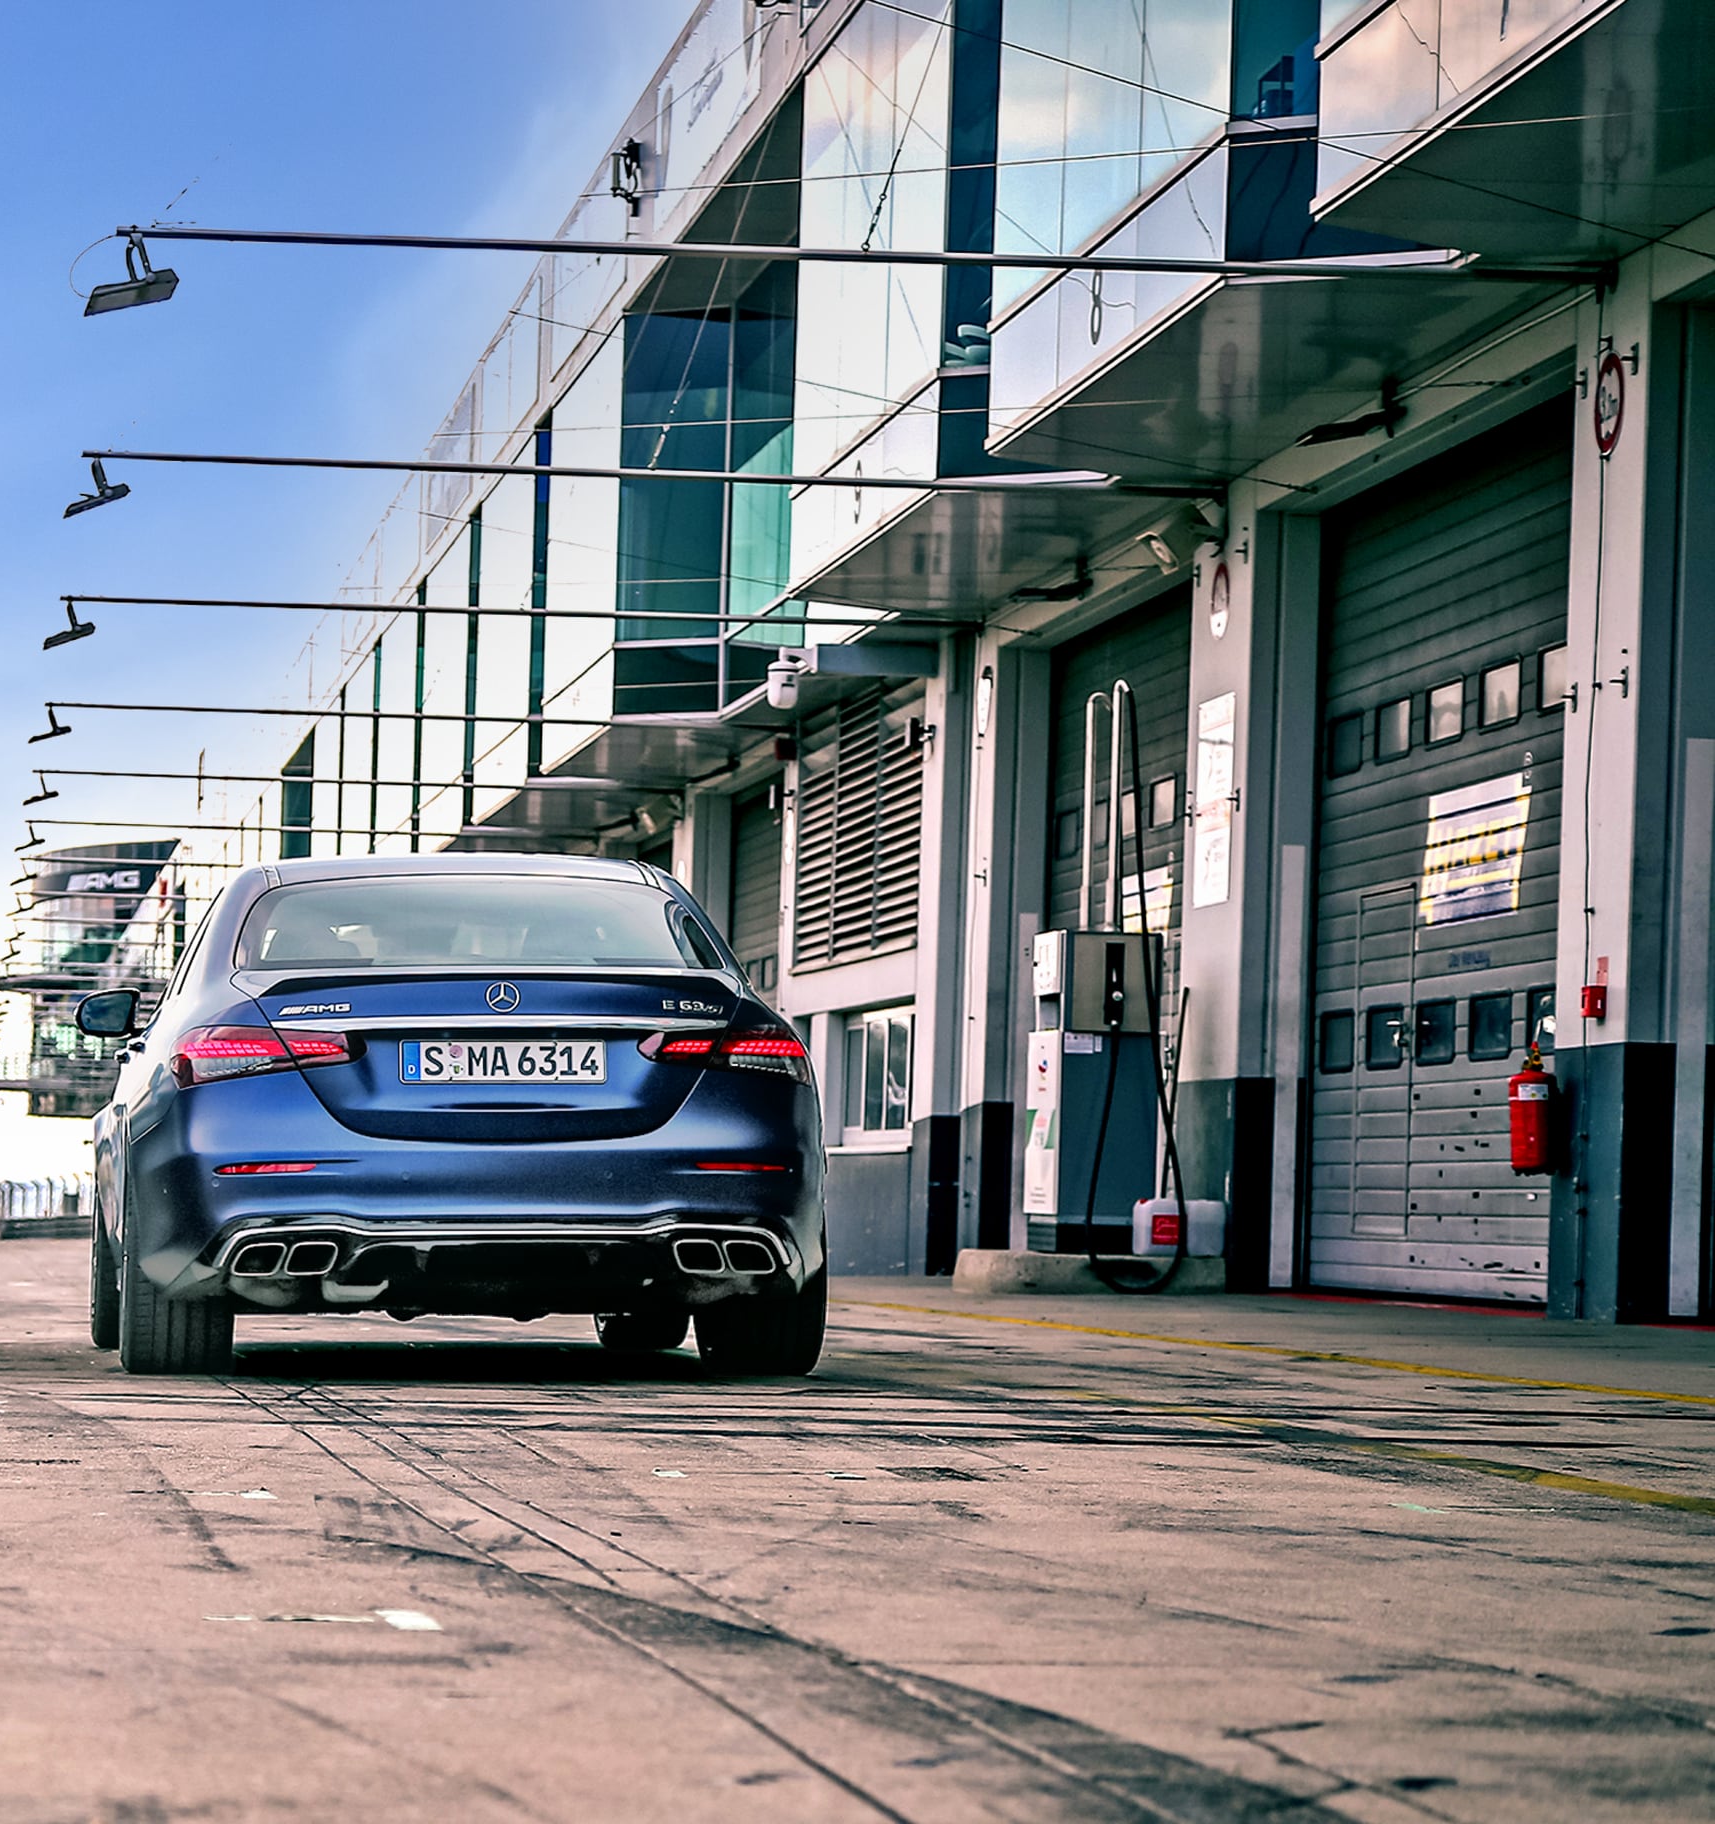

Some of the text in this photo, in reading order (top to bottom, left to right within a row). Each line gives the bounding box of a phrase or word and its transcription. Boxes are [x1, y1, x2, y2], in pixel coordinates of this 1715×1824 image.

[81, 870, 140, 891] AMG
[297, 1003, 351, 1015] AMG
[662, 1000, 675, 1010] E
[408, 1046, 599, 1076] D S MA 6314
